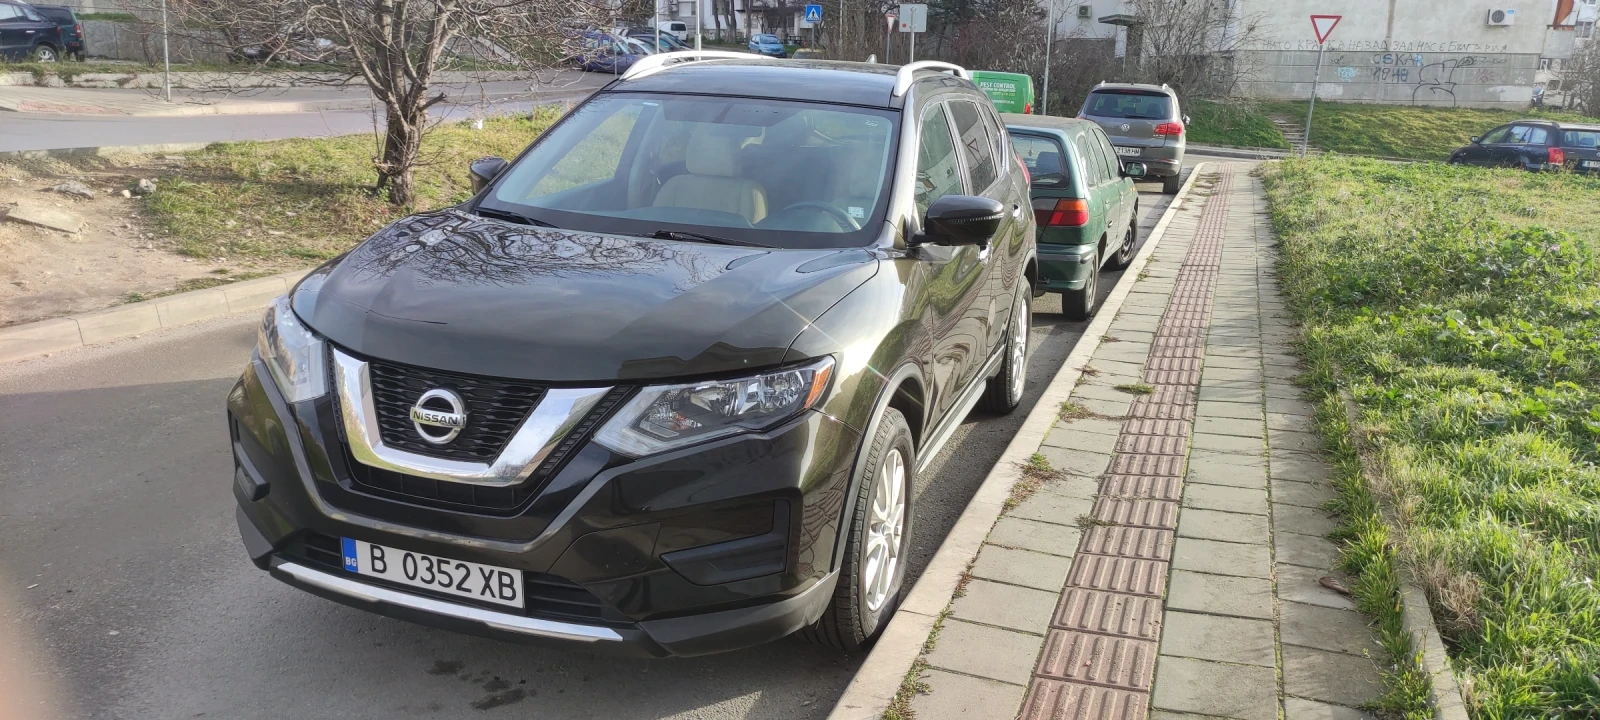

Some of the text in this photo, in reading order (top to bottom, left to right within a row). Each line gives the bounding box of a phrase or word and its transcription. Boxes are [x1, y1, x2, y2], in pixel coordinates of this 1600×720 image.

[1298, 39, 1345, 51] КРАКА
[413, 410, 458, 426] NISSAN
[345, 556, 357, 567] BG
[370, 543, 517, 601] B 0352 XB
